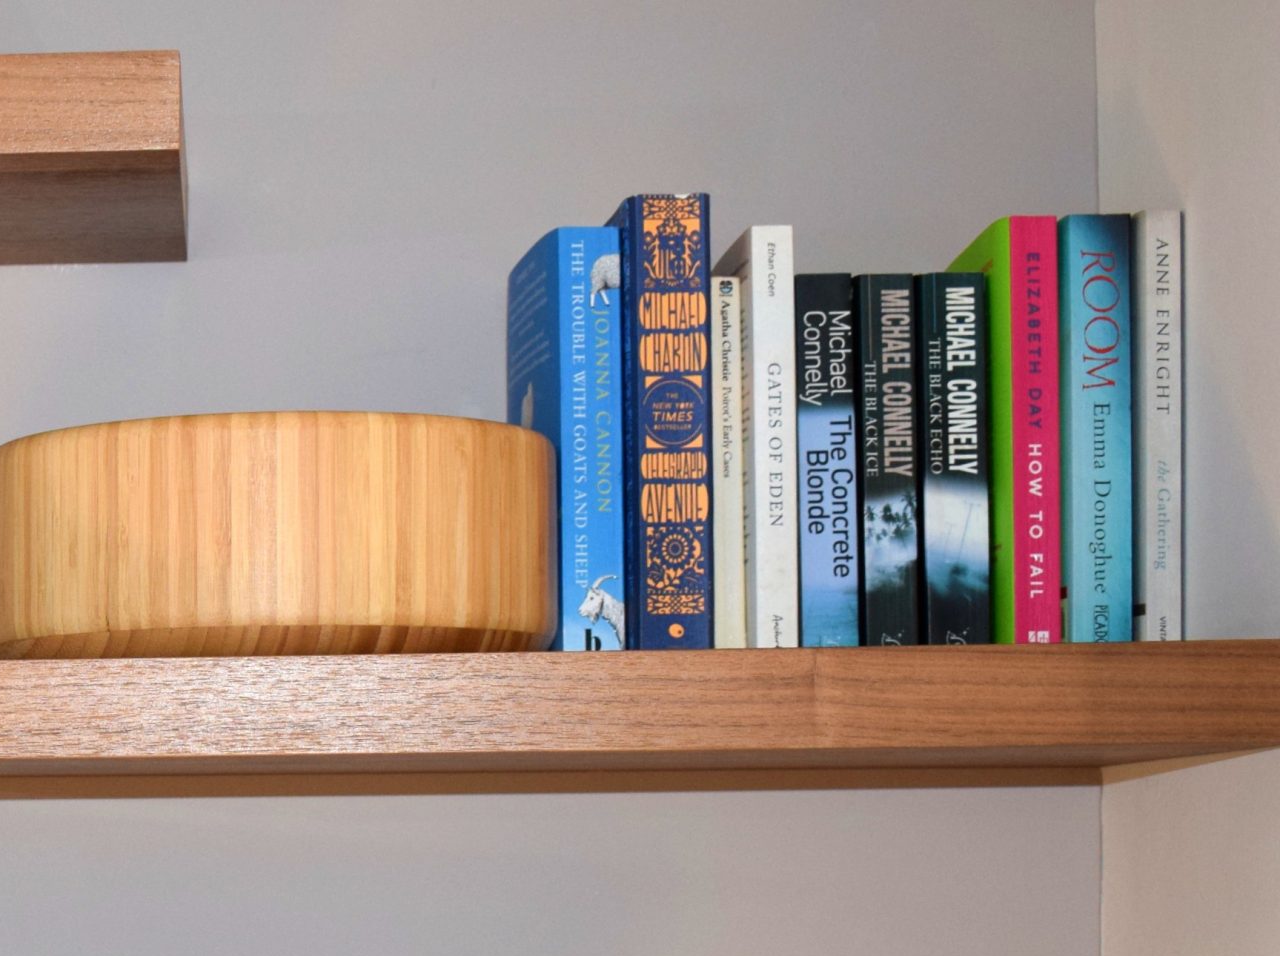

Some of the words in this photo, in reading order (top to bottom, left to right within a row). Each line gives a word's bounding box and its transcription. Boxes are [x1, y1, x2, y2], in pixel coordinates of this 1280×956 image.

[571, 241, 585, 276] THE
[767, 241, 778, 270] Ethan
[1156, 238, 1170, 297] ANNE
[640, 291, 706, 329] MICHAEL
[767, 272, 778, 297] Coen
[572, 280, 586, 365] TROUBLE
[720, 300, 732, 338] Agatha
[879, 289, 912, 373] MICHAEL
[944, 286, 976, 371] MICHAEL
[1025, 252, 1043, 374] ELIZABETH
[1080, 249, 1121, 391] ROOM
[592, 309, 611, 402] JOANNA
[640, 333, 707, 372] CHABON
[721, 340, 732, 382] Christie
[799, 310, 827, 406] Connelly
[828, 310, 852, 395] Michael
[864, 360, 878, 393] THE
[928, 337, 942, 370] THE
[1156, 309, 1171, 416] ENRIGHT
[572, 370, 587, 421] WITH
[652, 411, 694, 422] TIMES
[721, 386, 733, 421] Poirot's
[767, 362, 783, 429] GATES
[928, 372, 943, 425] BLACK
[1027, 387, 1043, 429] DAY
[719, 424, 733, 450] Early
[830, 415, 853, 461] The
[864, 396, 878, 448] BLACK
[881, 381, 913, 477] CONNELLY
[947, 379, 978, 475] CONNELLY
[1092, 402, 1110, 470] Emma
[572, 424, 588, 486] GOATS
[594, 410, 613, 513] CANNON
[721, 452, 733, 478] Cases
[768, 436, 783, 464] OF
[865, 451, 879, 477] ICE
[929, 428, 944, 475] ECHO
[1027, 443, 1044, 497] HOW
[1156, 459, 1170, 483] the
[573, 490, 588, 529] AND
[641, 483, 708, 523] AVENUE
[769, 471, 785, 528] EDEN
[806, 449, 830, 535] Blonde
[830, 467, 854, 578] Concrete
[1028, 510, 1044, 539] TO
[1088, 479, 1112, 595] Donoghue
[1153, 488, 1172, 570] Gathering
[575, 533, 589, 588] SHEEP
[1028, 553, 1045, 598] FAIL
